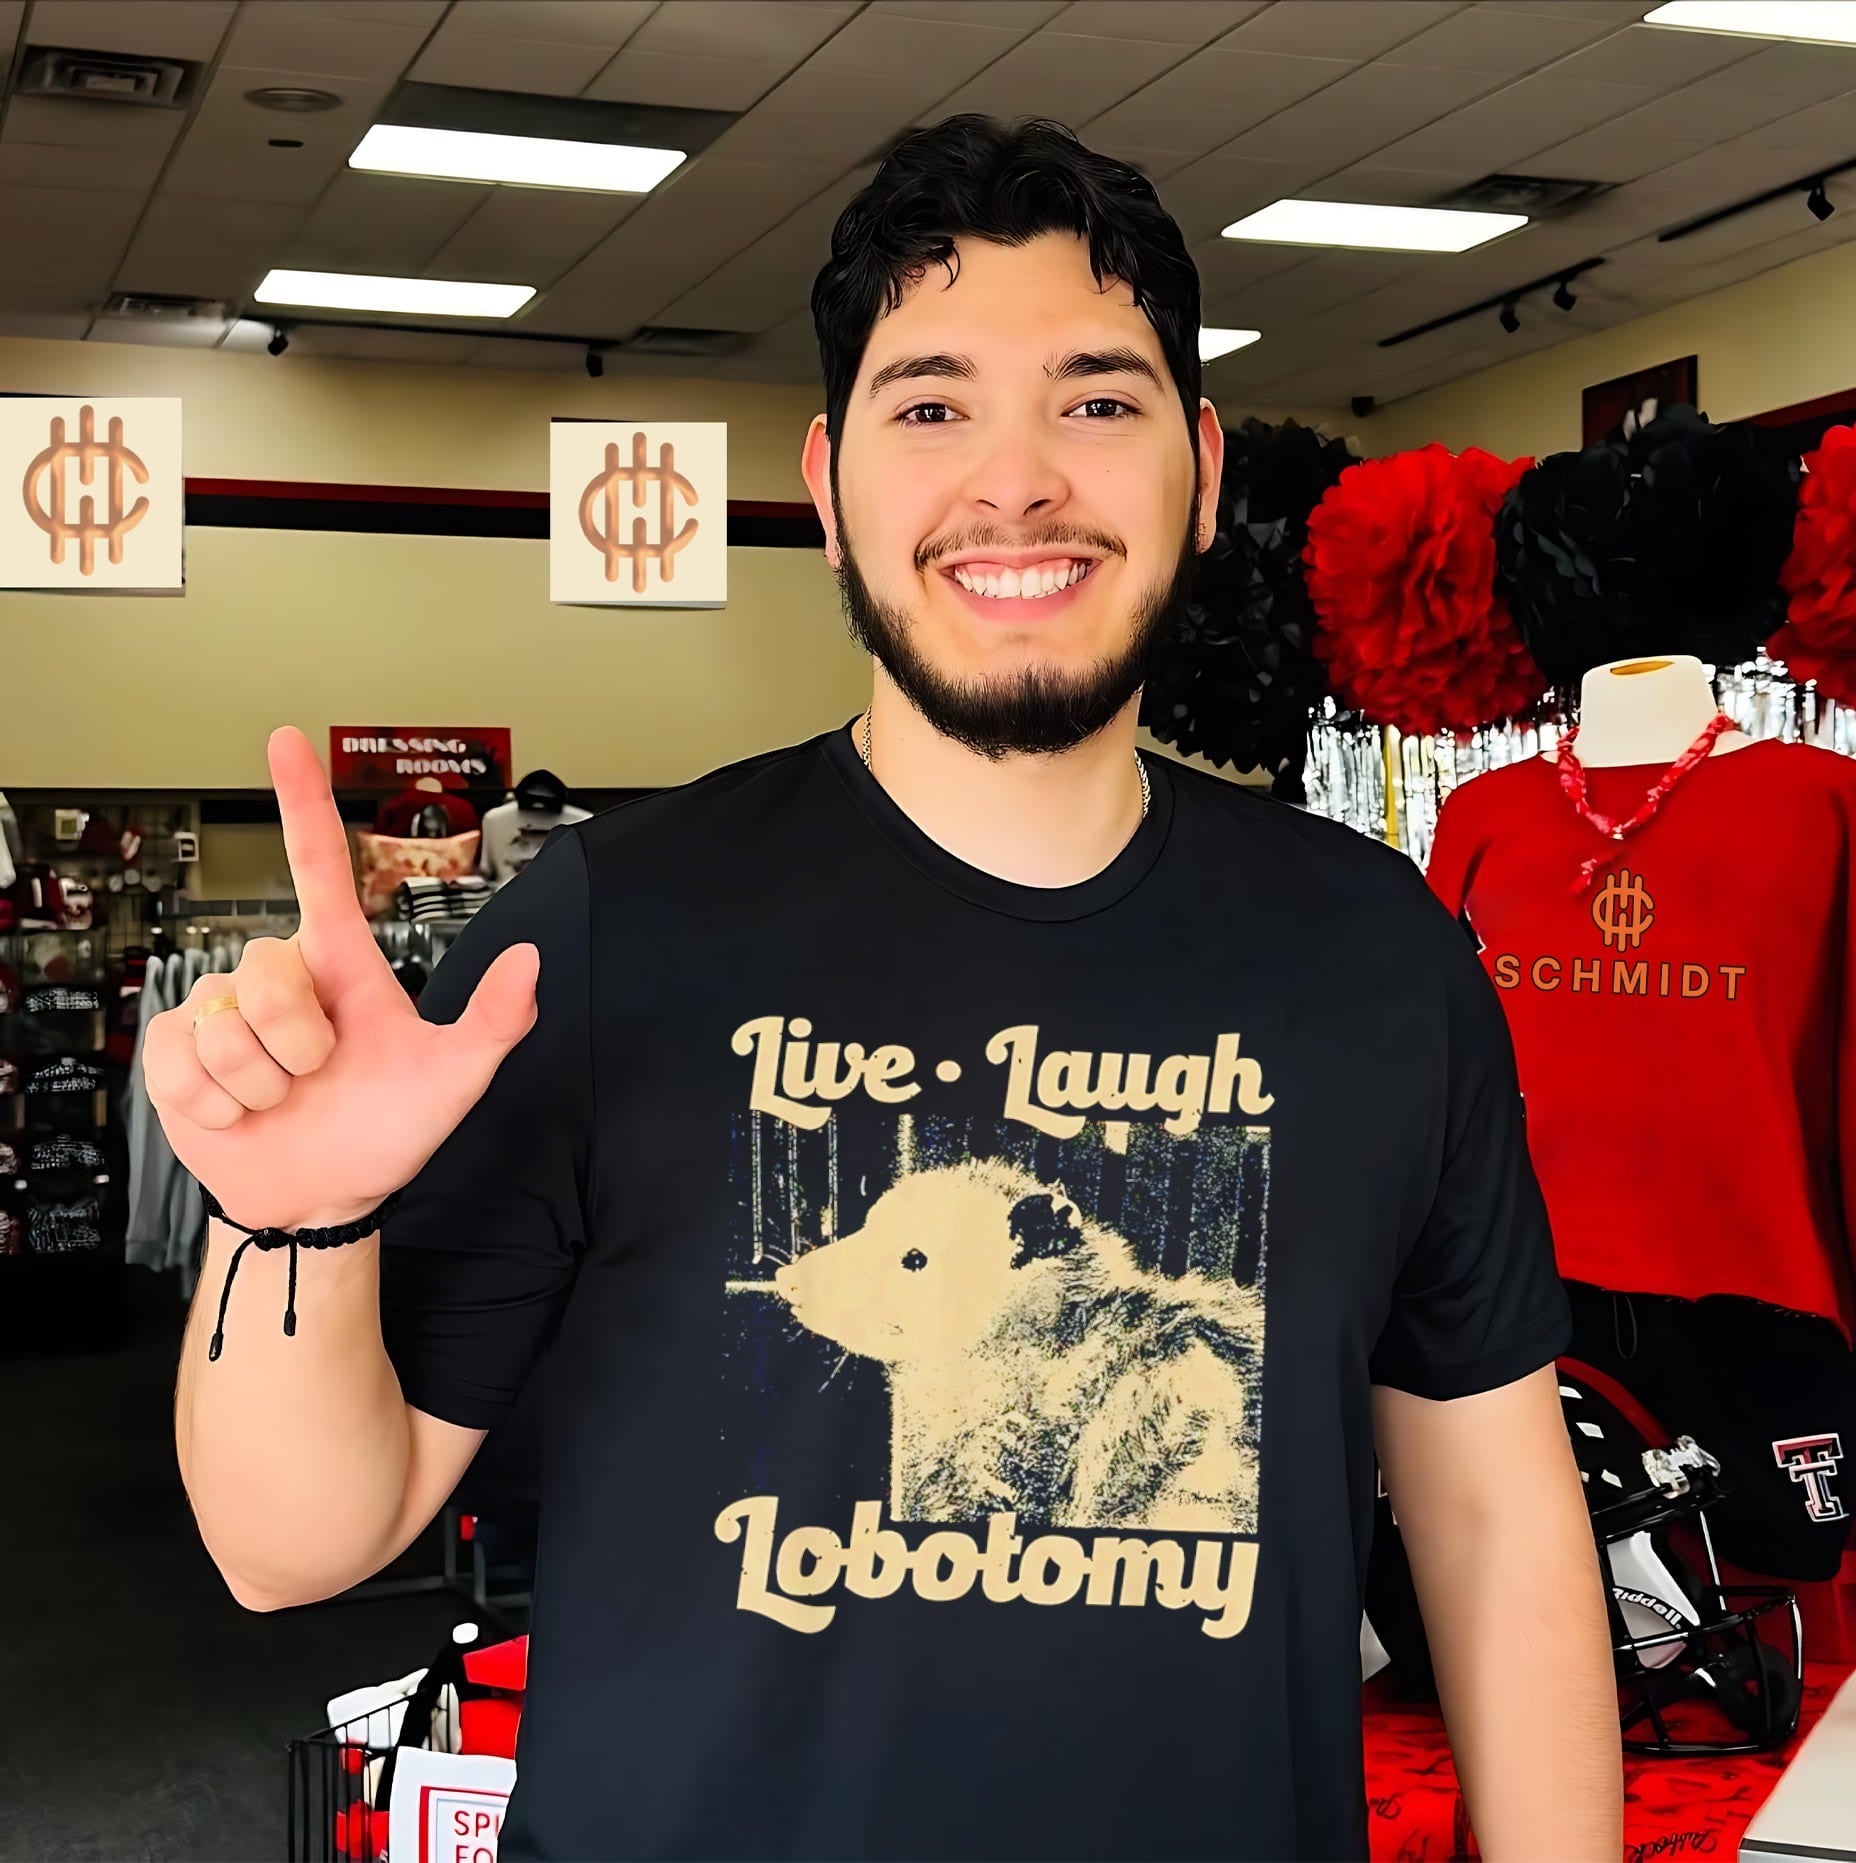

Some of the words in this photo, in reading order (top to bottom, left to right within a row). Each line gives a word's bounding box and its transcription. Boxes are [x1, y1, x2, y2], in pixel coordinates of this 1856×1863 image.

[342, 737, 467, 754] DRESSING
[396, 758, 487, 775] ROOMS
[1494, 954, 1746, 1000] SCHMIDT
[731, 1016, 922, 1131] Live
[985, 1024, 1275, 1140] Laugh
[714, 1496, 1260, 1639] Lobotomy
